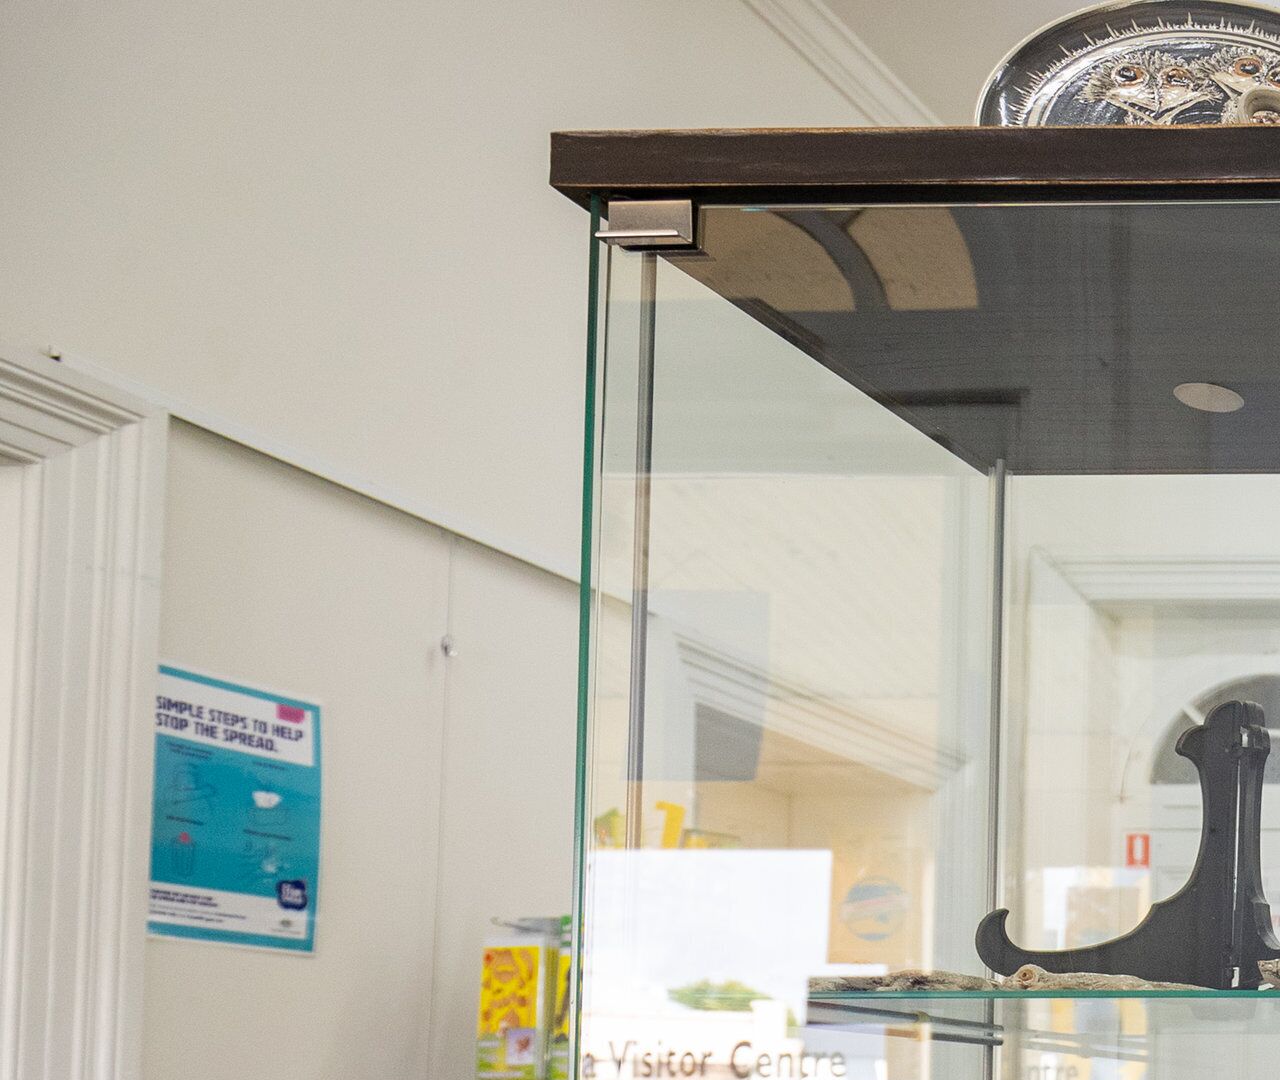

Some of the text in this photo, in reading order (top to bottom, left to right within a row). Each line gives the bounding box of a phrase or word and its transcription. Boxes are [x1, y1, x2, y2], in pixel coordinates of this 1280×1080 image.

[155, 712, 189, 731] STOP
[194, 721, 219, 739] THE
[156, 695, 304, 742] SIMPLE STEPS TO HELP
[608, 1040, 713, 1078] Visitor
[730, 1041, 847, 1079] Centre
